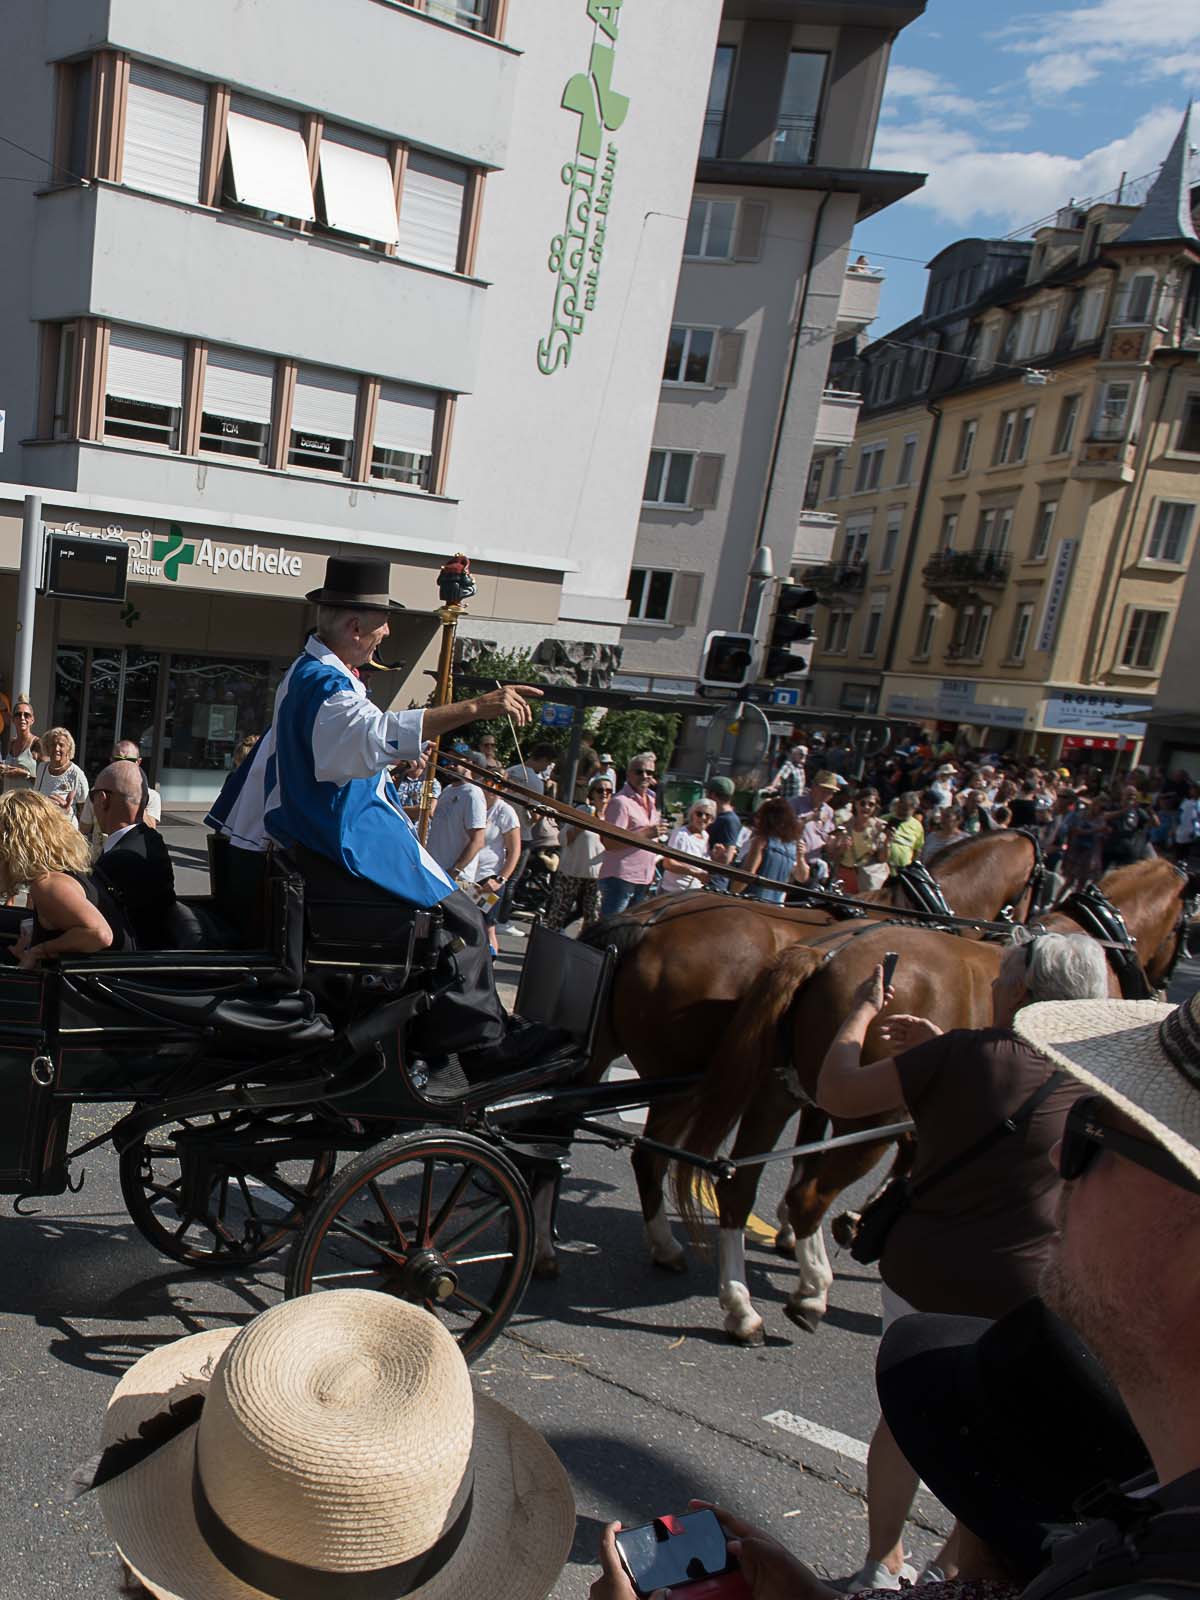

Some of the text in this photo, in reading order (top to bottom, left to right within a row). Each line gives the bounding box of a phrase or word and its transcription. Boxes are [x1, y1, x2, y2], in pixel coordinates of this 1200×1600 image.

[584, 142, 619, 312] mit der Natur
[537, 162, 597, 375] Späni
[221, 422, 240, 435] TCM
[132, 561, 161, 576] Natur
[196, 538, 303, 577] Apotheke
[1062, 692, 1123, 709] ROBI'S
